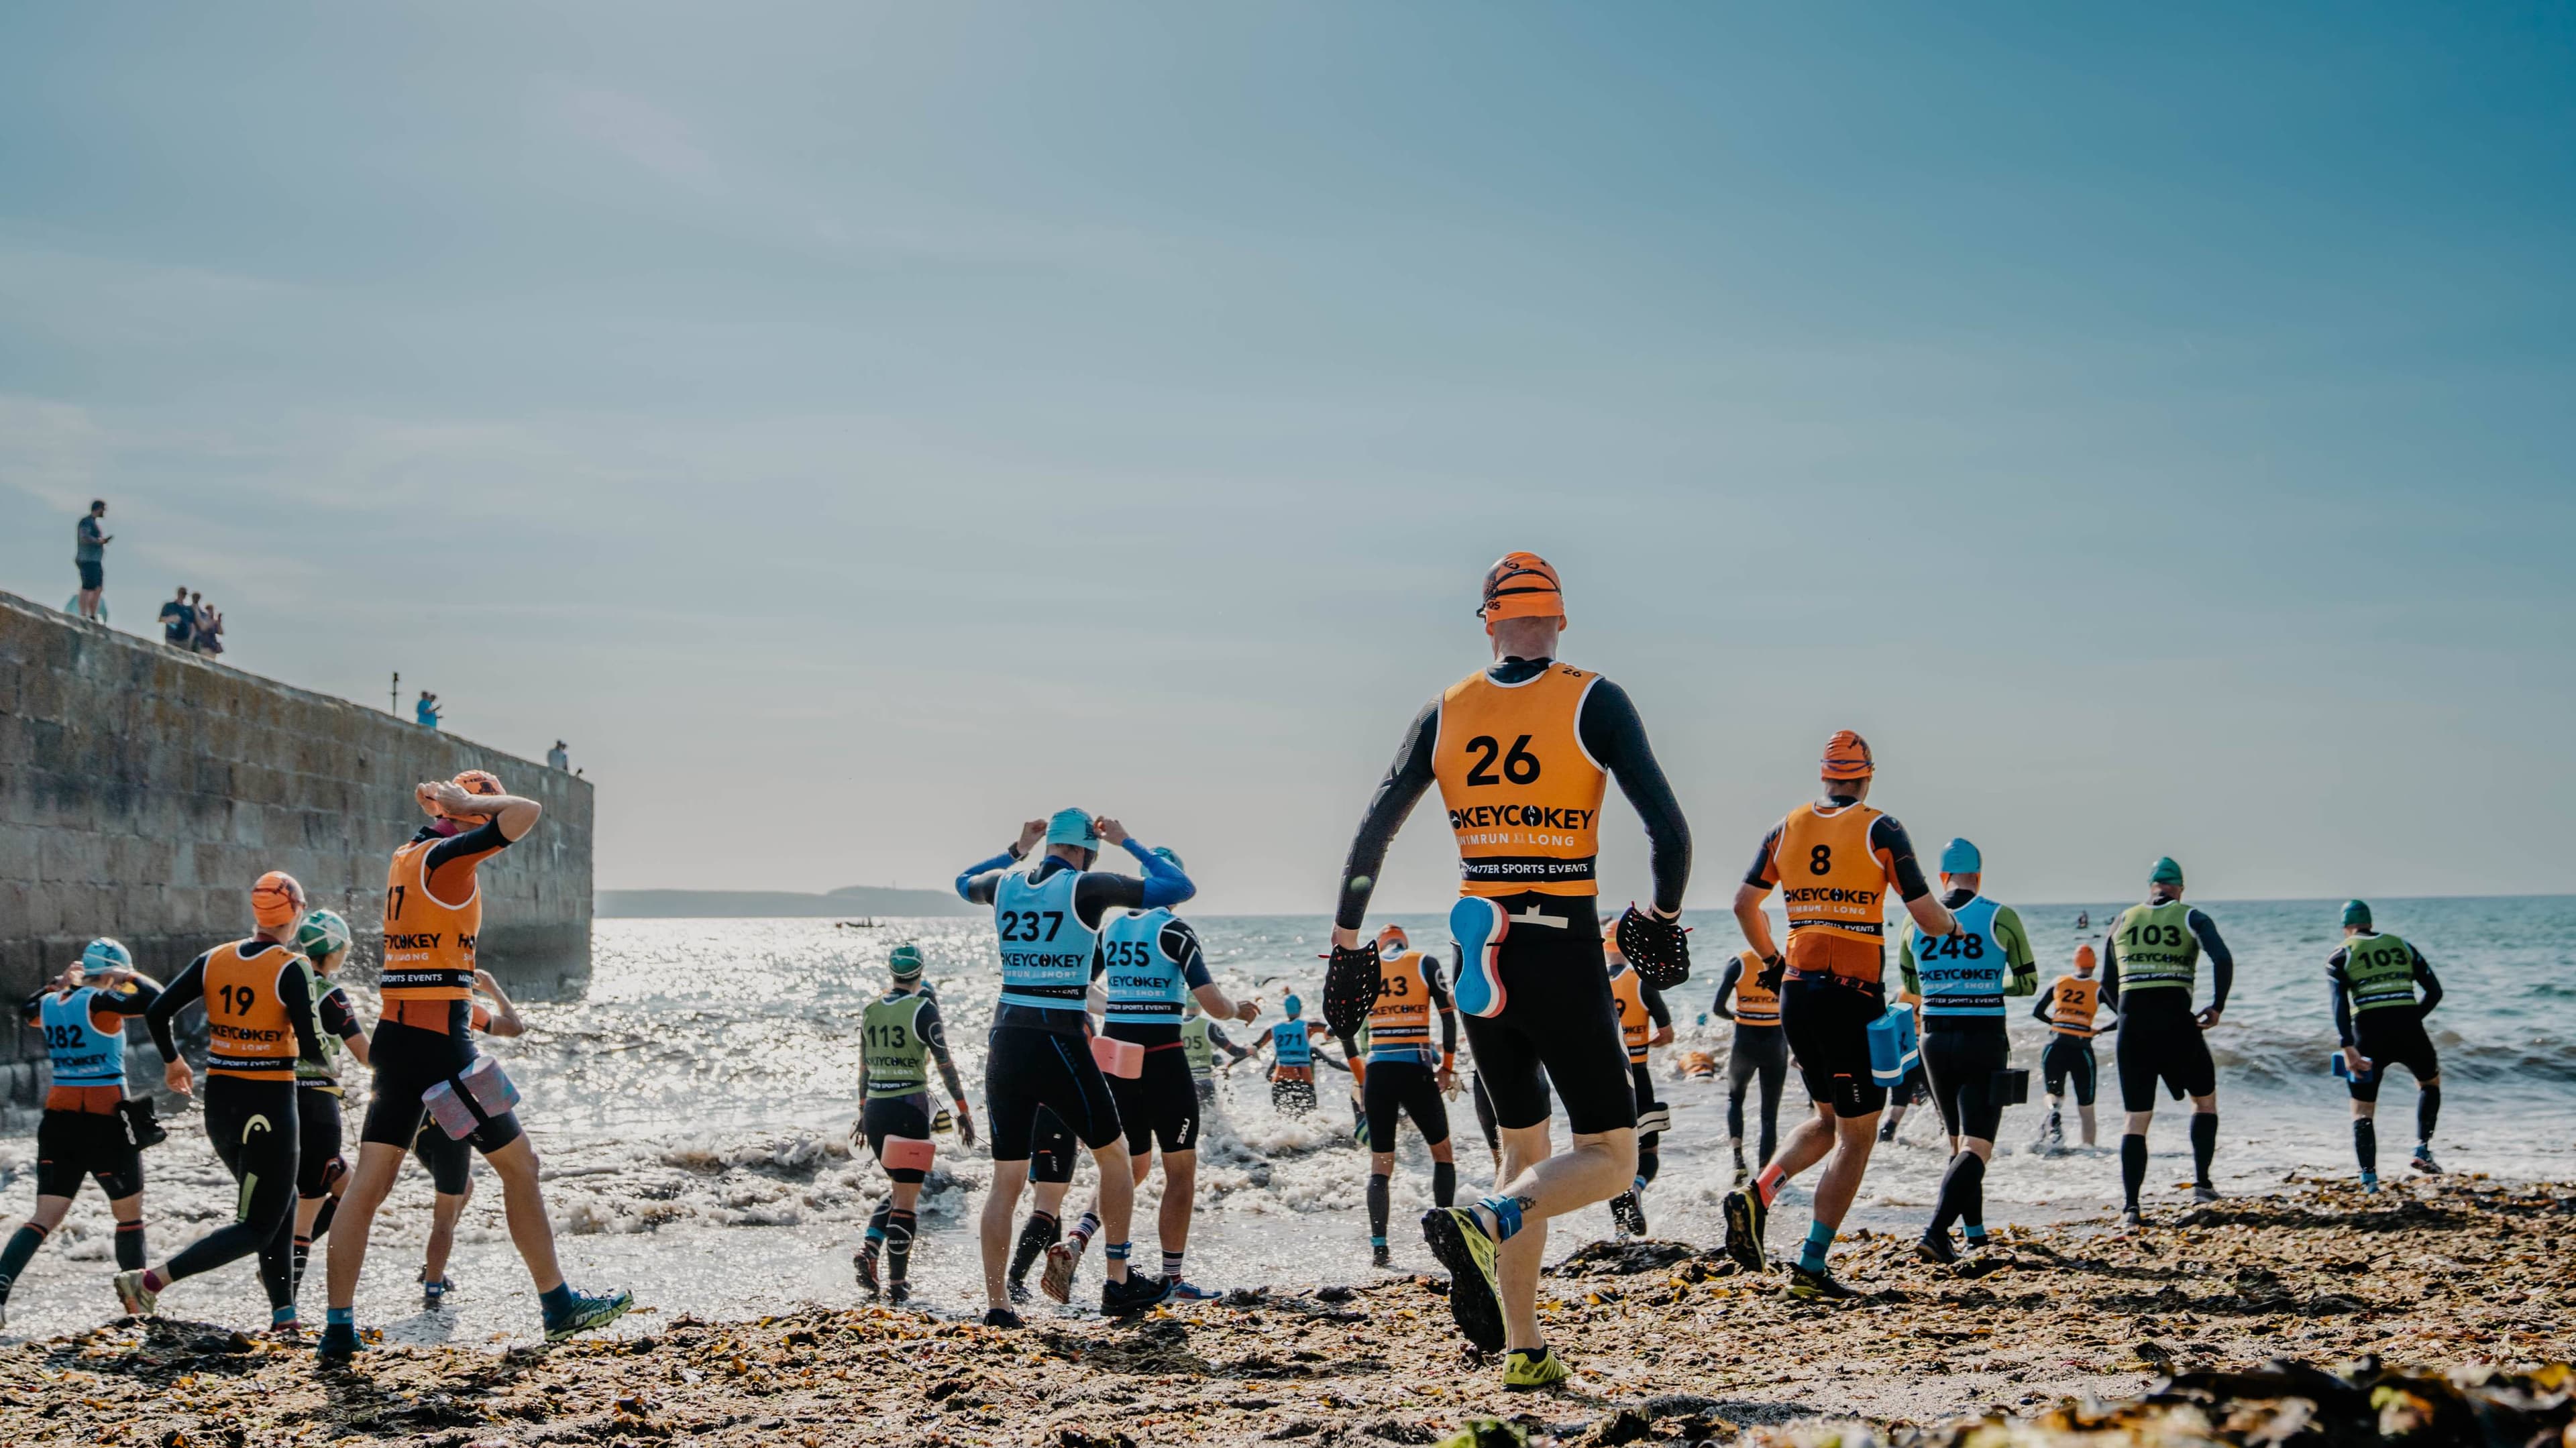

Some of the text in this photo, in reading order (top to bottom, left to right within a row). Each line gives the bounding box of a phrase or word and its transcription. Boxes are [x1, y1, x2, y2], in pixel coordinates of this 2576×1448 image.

[1562, 668, 1581, 677] 26
[1465, 734, 1541, 787] 26
[1529, 834, 1574, 846] LONG
[1501, 864, 1545, 874] SPORTS
[1549, 863, 1589, 874] EVENTS
[1810, 844, 1831, 876] 8
[387, 885, 405, 921] 17
[1833, 905, 1866, 915] LONG
[1002, 910, 1064, 942] 237
[2126, 924, 2182, 947] 103
[1106, 940, 1150, 967] 255
[1920, 932, 1984, 961] 248
[2358, 947, 2408, 970] 103
[407, 974, 443, 983] EVENTS
[1041, 970, 1077, 979] SHORT
[1380, 975, 1408, 997] 43
[219, 984, 255, 1016] 19
[2061, 989, 2086, 1005] 22
[46, 1024, 87, 1049] 282
[241, 1043, 271, 1052] LONG
[867, 1024, 906, 1048] 113
[1277, 1033, 1303, 1048] 271
[1177, 1117, 1191, 1145] 2XU
